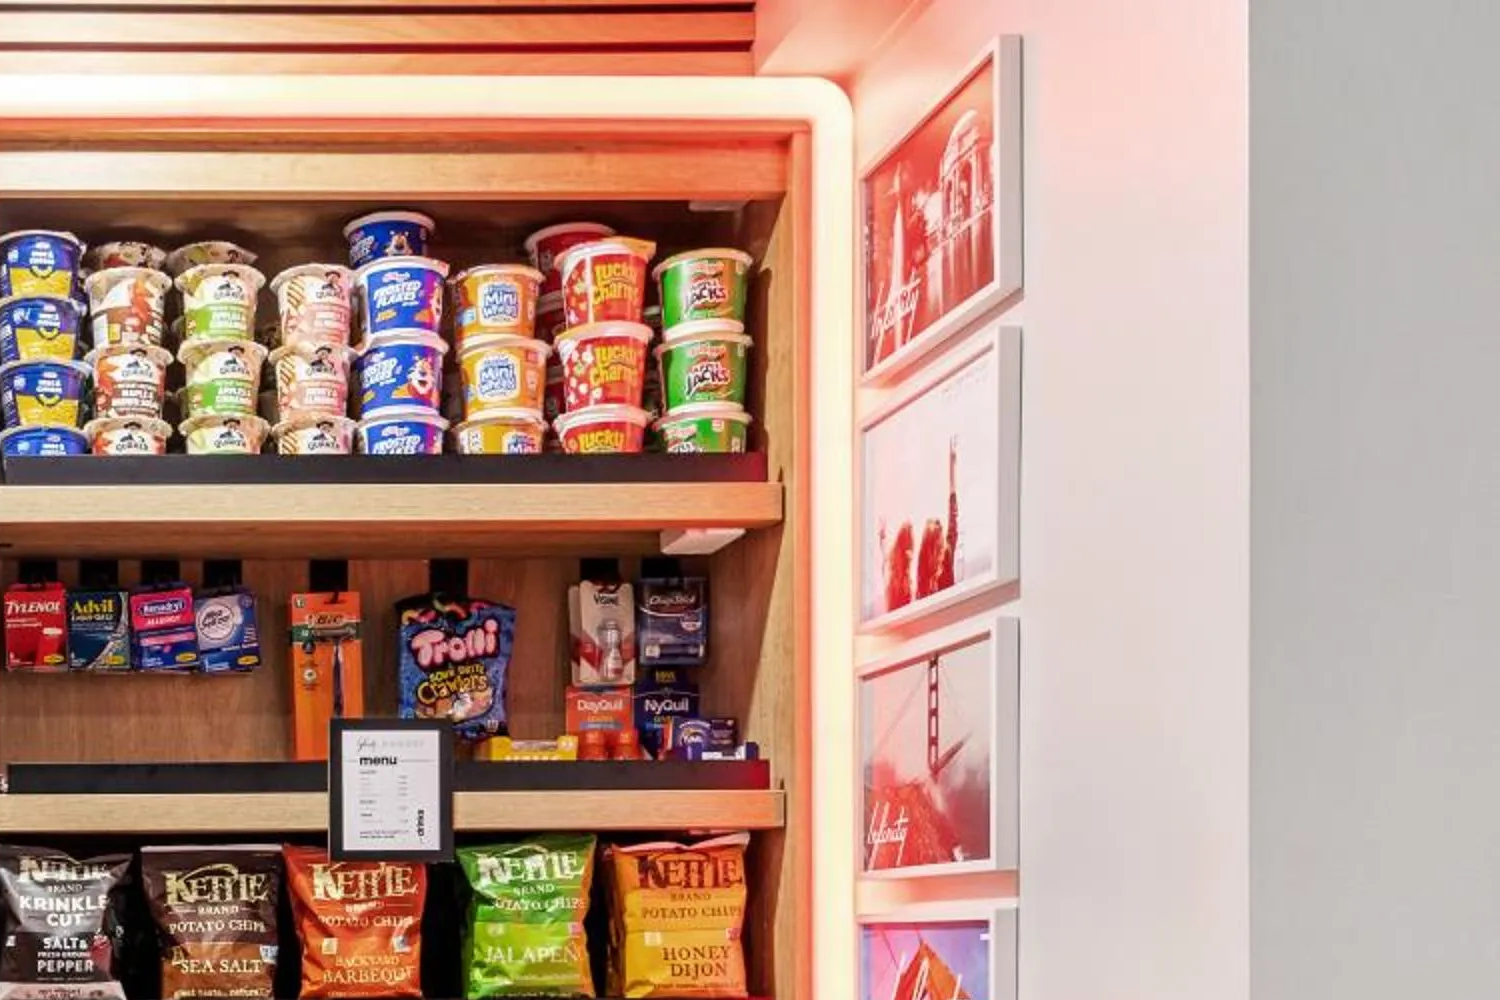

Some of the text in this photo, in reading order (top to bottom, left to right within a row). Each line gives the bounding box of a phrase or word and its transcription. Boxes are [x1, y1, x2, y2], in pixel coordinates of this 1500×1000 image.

[73, 599, 113, 613] Advil
[411, 618, 500, 668] Trolli
[577, 699, 623, 714] DayQuil
[644, 699, 689, 715] NyQuil
[359, 757, 398, 766] menu
[308, 861, 418, 901] KETTLE
[19, 895, 110, 913] KRINKLE
[198, 905, 240, 915] BRAND
[46, 913, 85, 928] CUT
[641, 907, 698, 920] POTATO
[168, 920, 225, 934] POTATO
[43, 937, 77, 950] SALT
[662, 945, 732, 961] HONEY
[37, 960, 94, 974] PEPPER
[181, 959, 263, 974] SEA SALT
[670, 963, 728, 980] DIJON
